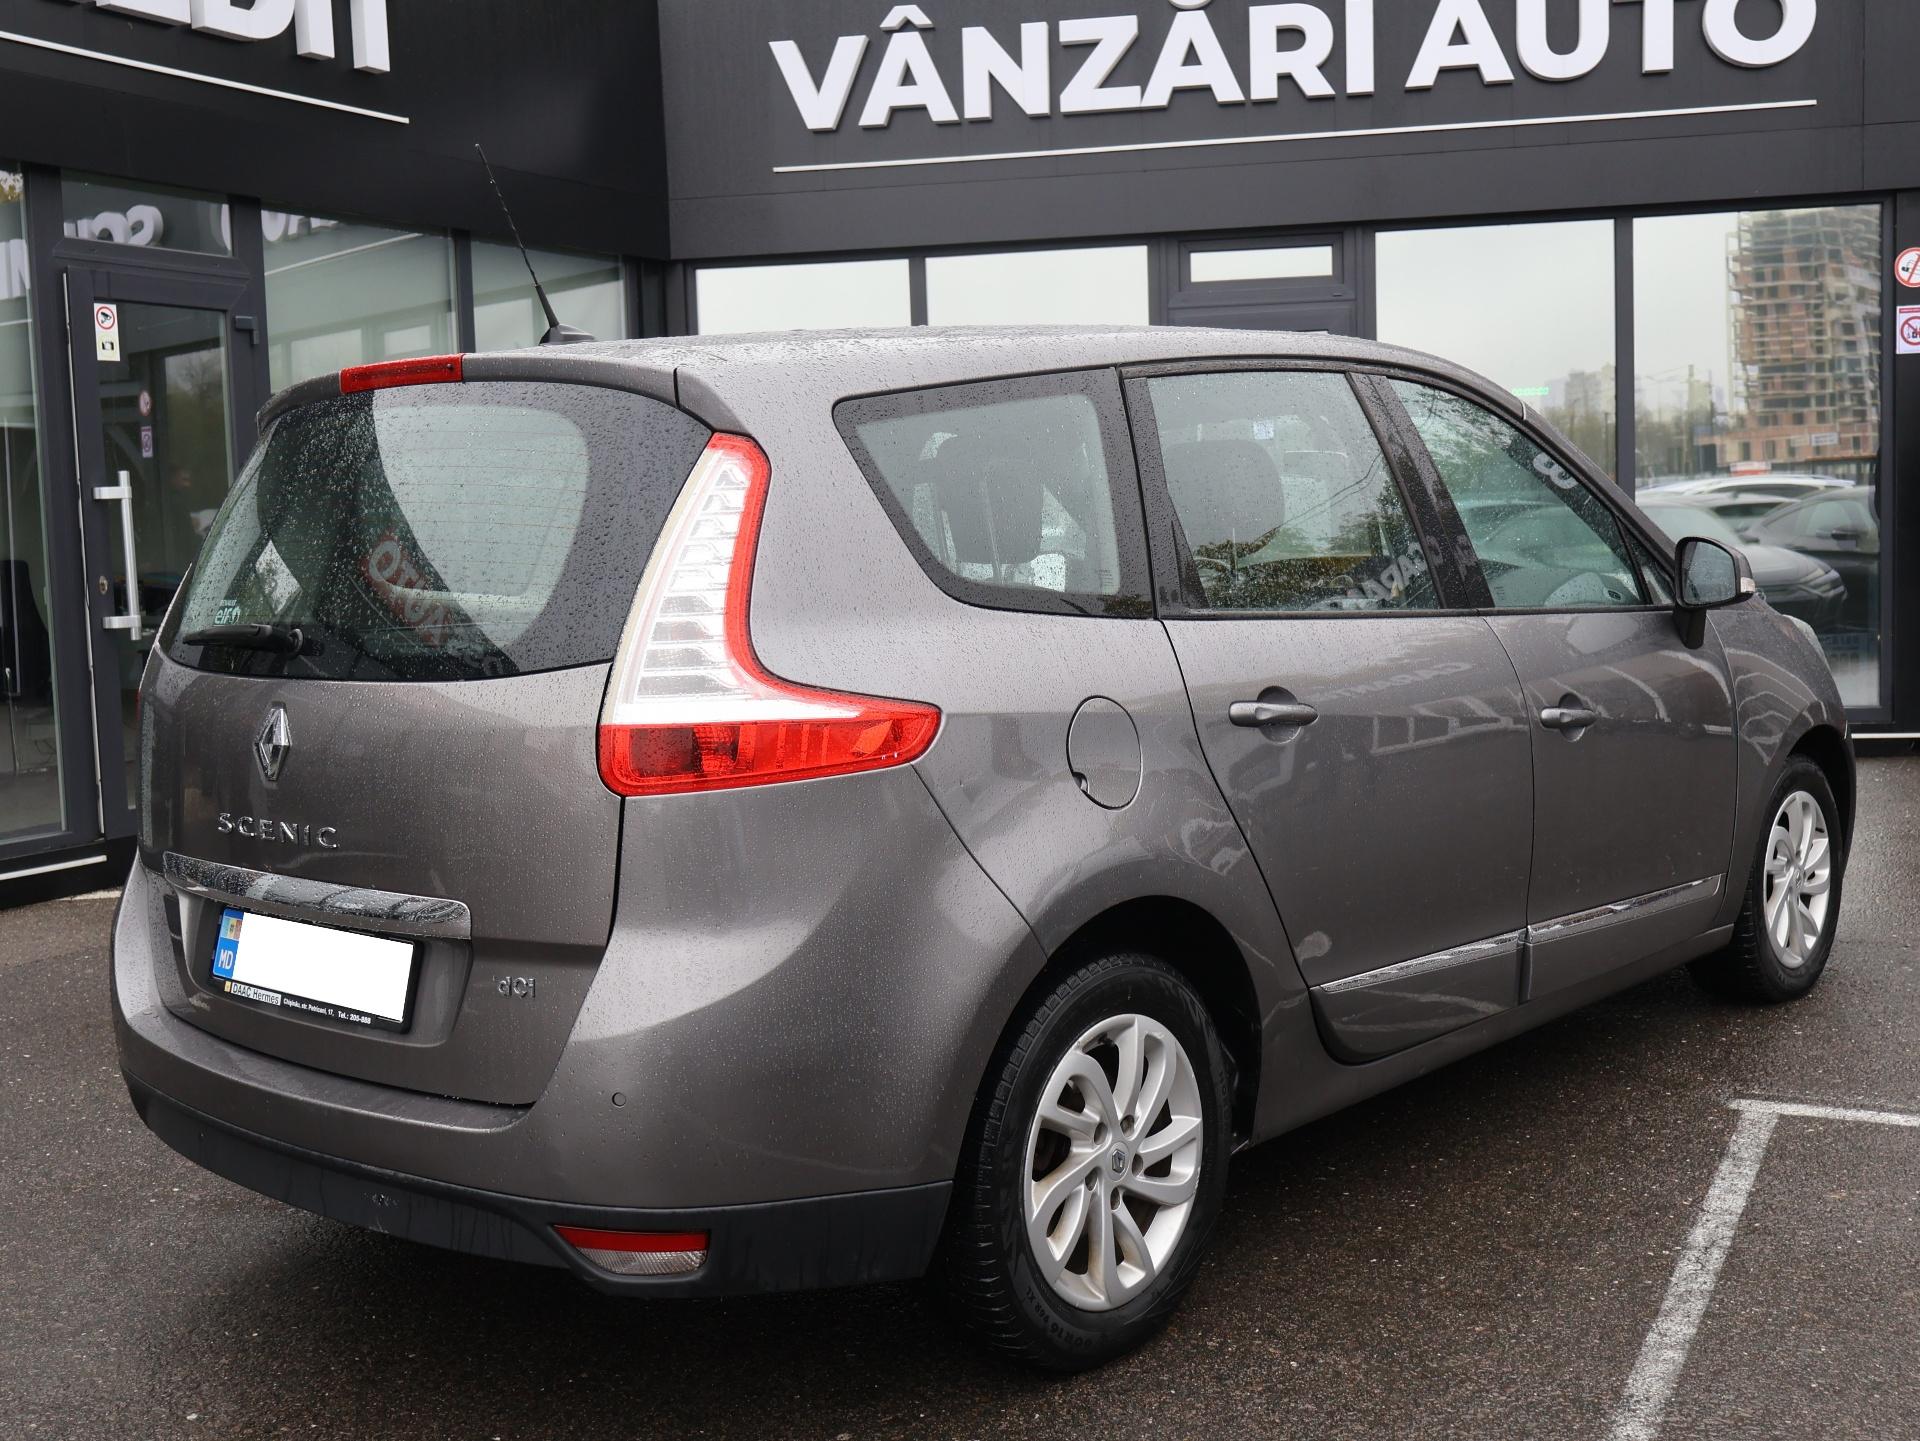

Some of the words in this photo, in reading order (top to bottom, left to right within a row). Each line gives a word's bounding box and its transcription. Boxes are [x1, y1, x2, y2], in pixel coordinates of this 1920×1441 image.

[769, 0, 1375, 132] VÂNZĂRI
[1404, 0, 1818, 91] AUTO
[218, 812, 339, 849] SCENIC
[218, 949, 234, 970] MD
[232, 983, 252, 998] DAAC
[253, 989, 280, 1006] Hermes
